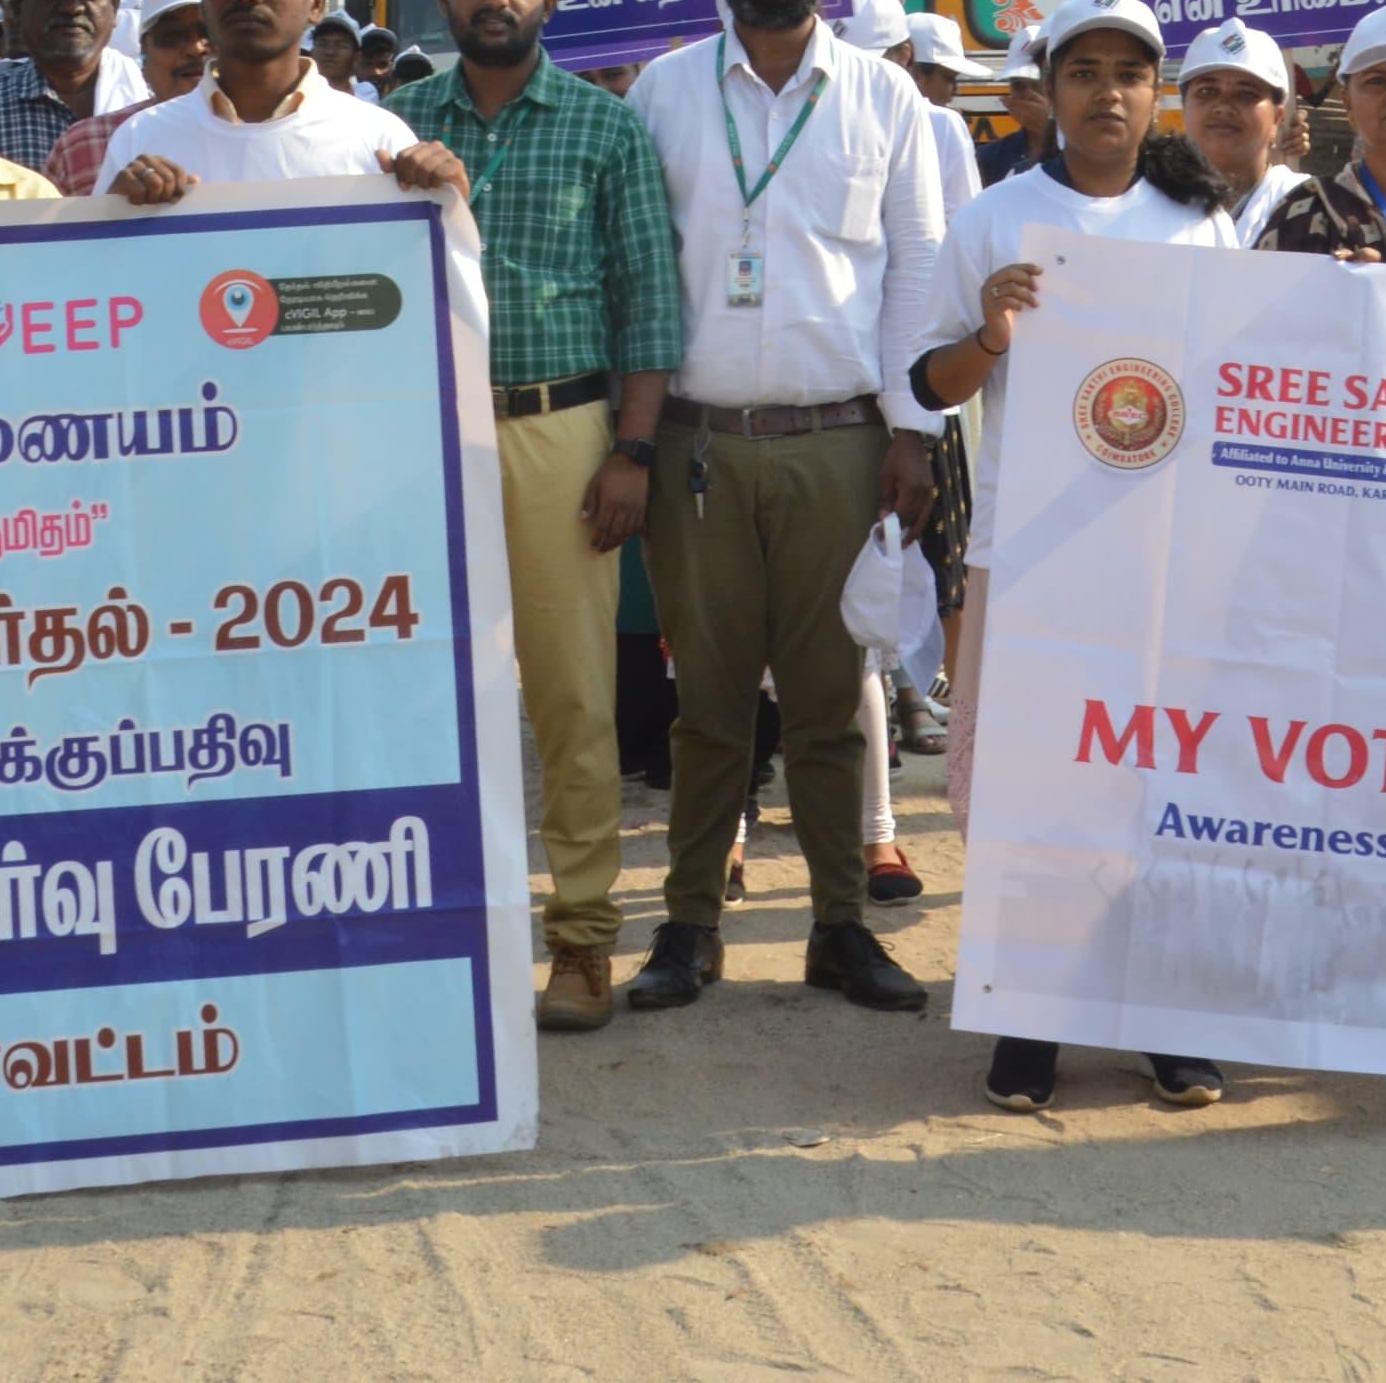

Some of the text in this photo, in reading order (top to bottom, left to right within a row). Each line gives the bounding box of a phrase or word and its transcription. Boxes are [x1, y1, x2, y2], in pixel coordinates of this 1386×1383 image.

[323, 306, 348, 320] App
[1217, 361, 1331, 407] SREE
[1220, 447, 1274, 464] Affiliated
[1275, 455, 1289, 466] to
[1290, 454, 1321, 469] Anna
[1323, 458, 1381, 478] University
[1235, 474, 1274, 489] OOTY
[1276, 478, 1314, 493] MAIN
[1317, 483, 1359, 499] ROAD,
[213, 574, 421, 653] 2024
[1073, 698, 1221, 775] MY
[134, 815, 434, 939] பேரணி
